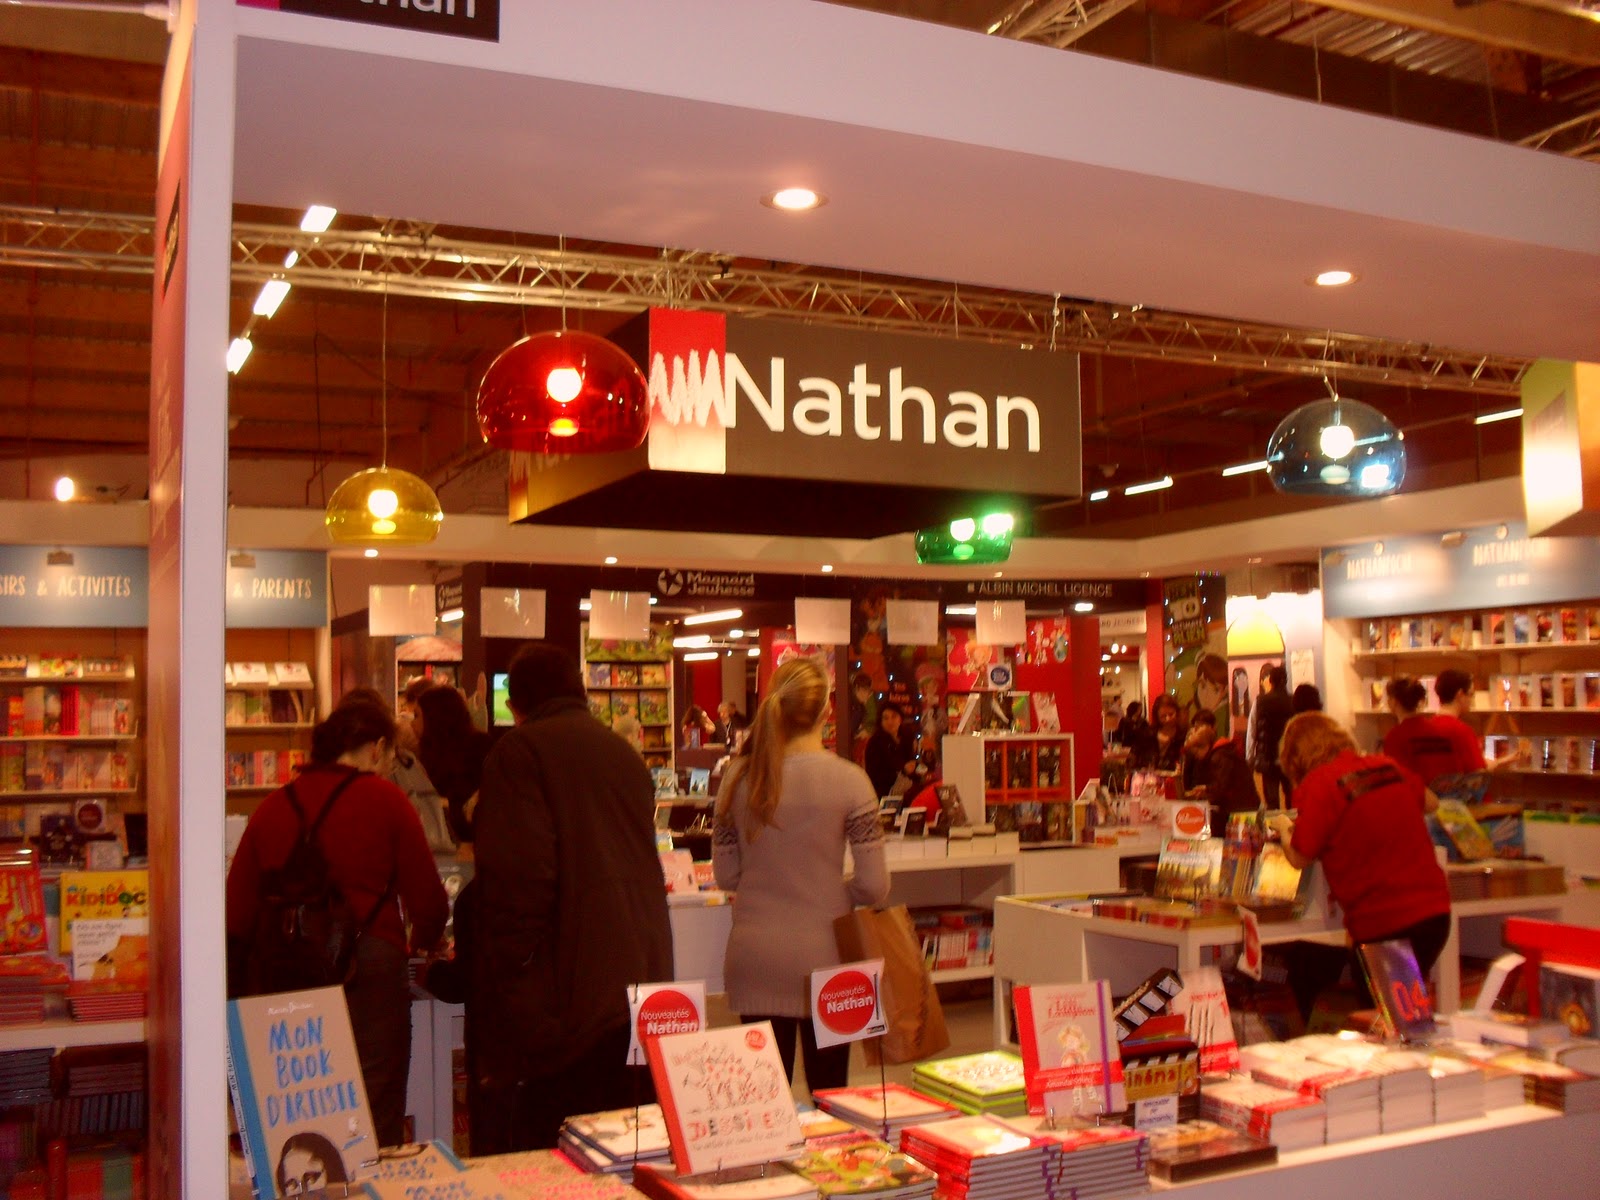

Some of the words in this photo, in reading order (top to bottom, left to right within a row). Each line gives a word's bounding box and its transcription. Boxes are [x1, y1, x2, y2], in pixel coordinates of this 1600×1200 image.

[724, 352, 1041, 453] Nathan
[36, 579, 49, 597] &
[252, 577, 312, 600] PARENTS
[978, 582, 1014, 595] ALBIN
[1017, 583, 1059, 597] MICHEL
[1063, 583, 1113, 598] LICENCE
[820, 985, 866, 1001] Nouveautés
[826, 995, 874, 1014] Nathan
[640, 1009, 690, 1020] Nouveautés
[646, 1020, 698, 1035] Nathan
[276, 1048, 332, 1089] BOOK
